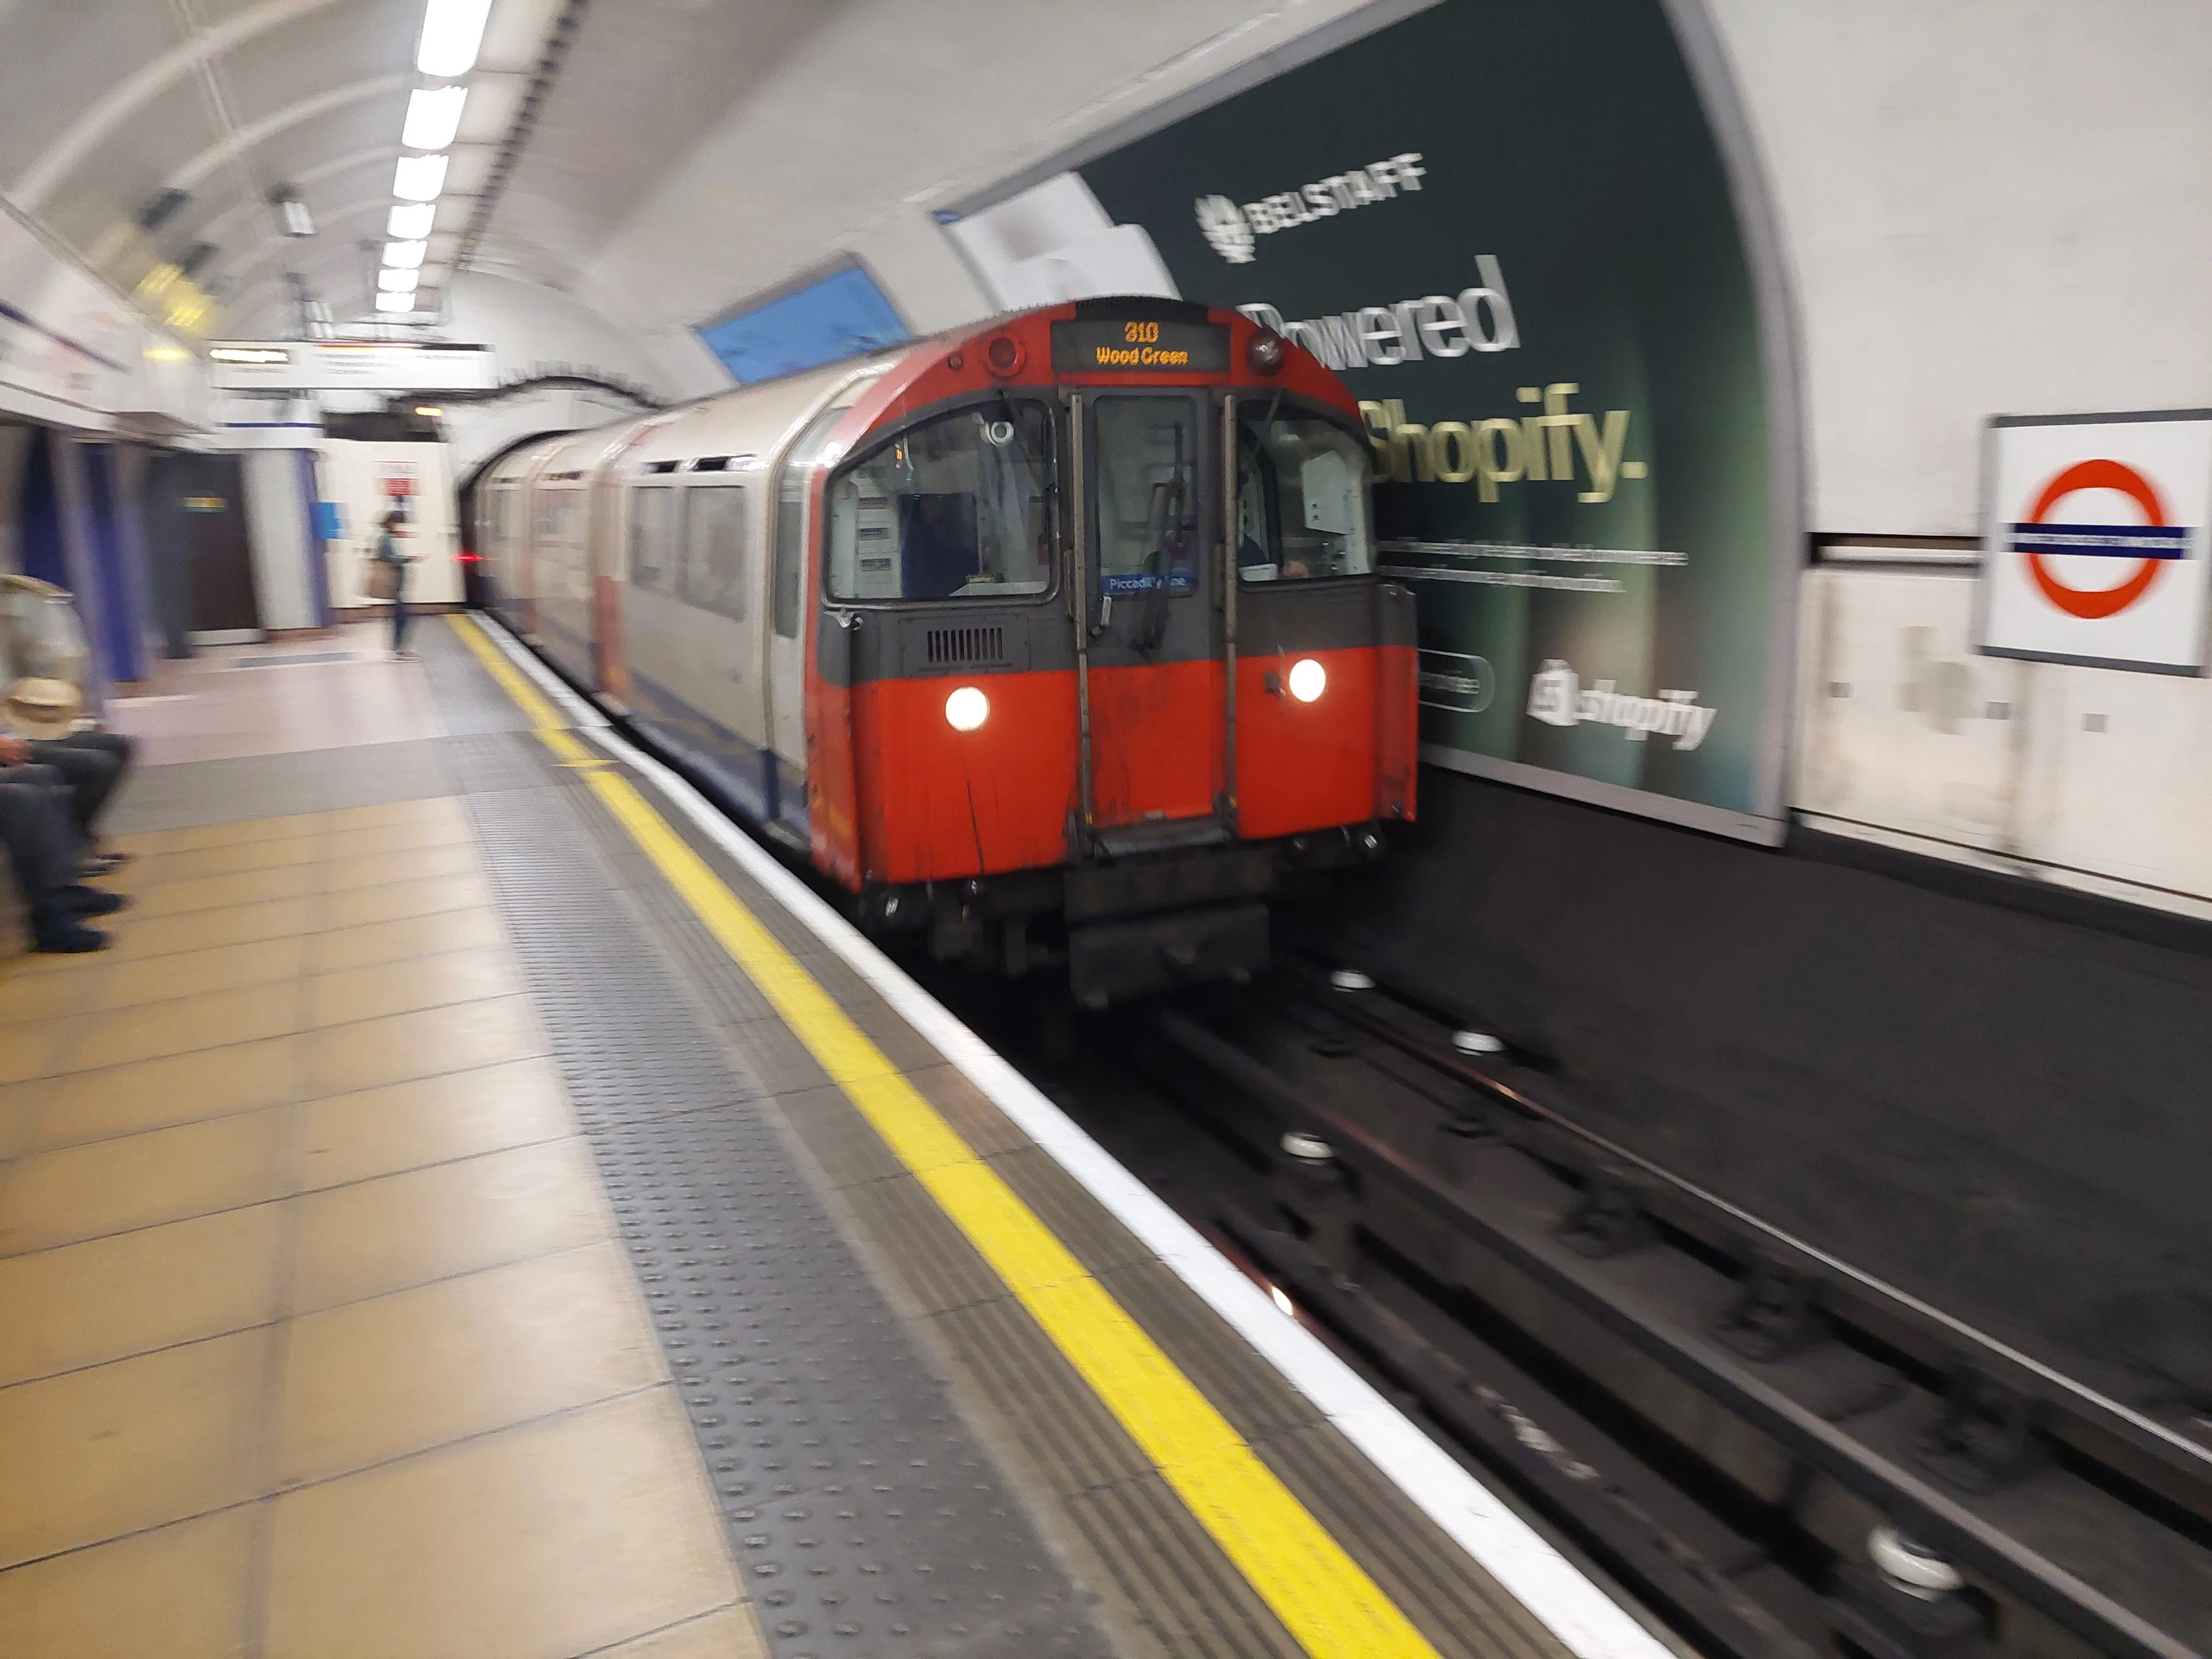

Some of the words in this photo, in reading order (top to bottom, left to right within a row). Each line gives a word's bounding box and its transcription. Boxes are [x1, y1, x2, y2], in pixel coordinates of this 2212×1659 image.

[1240, 152, 1428, 234] BELSTAFF
[1095, 346, 1140, 365] Wood
[1141, 346, 1189, 365] Green
